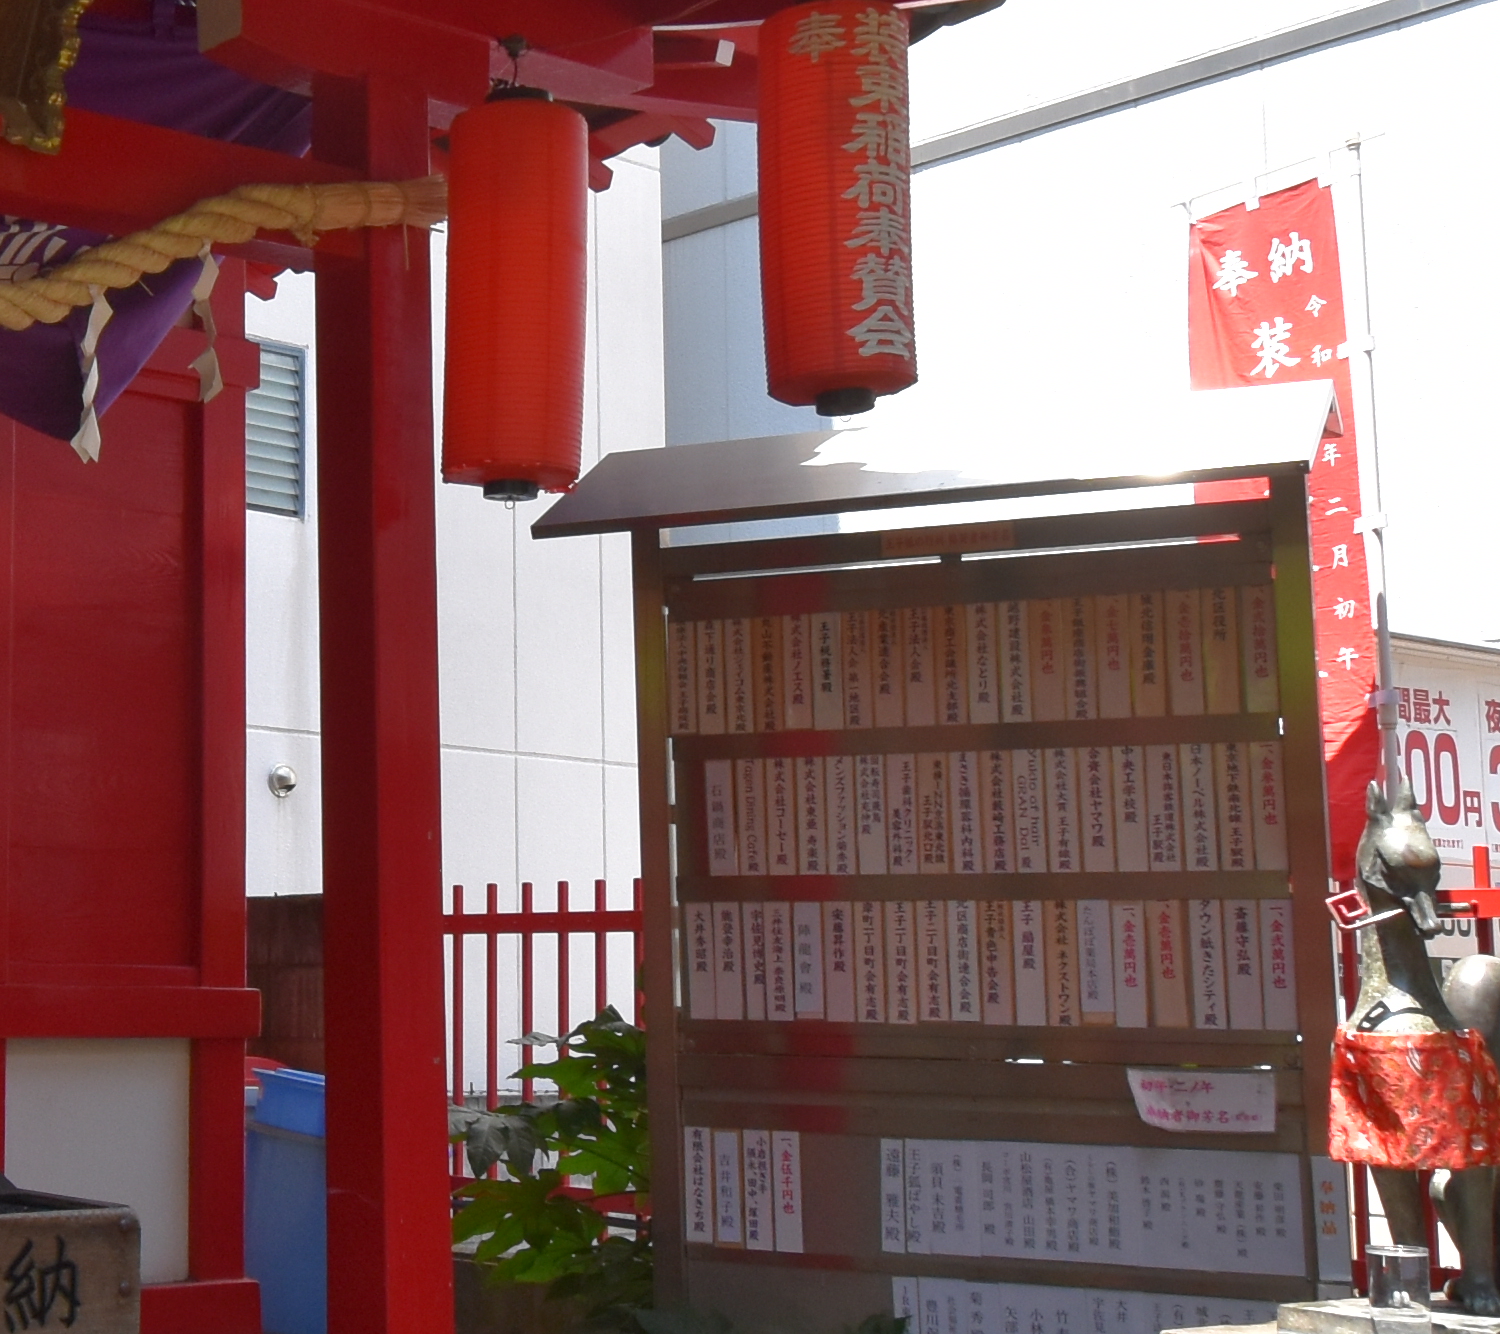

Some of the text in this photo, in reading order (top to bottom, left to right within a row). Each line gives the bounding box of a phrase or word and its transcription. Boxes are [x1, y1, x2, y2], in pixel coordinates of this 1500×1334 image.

[788, 10, 848, 65] 奉
[841, 6, 912, 361] 装束稲荷奉賛会
[1213, 231, 1314, 298] 奉納
[1250, 317, 1301, 379] 装
[1306, 293, 1359, 672] 令和年二月初午
[975, 603, 990, 704] 株式会社なとり殿
[1121, 745, 1138, 824] 中央工学校殿
[1190, 742, 1209, 868] 日本ノーベル株式会社殿
[694, 910, 707, 973] 大井秀昭殿
[719, 1153, 734, 1228] 吉井和子殿
[3, 1235, 82, 1334] 納
